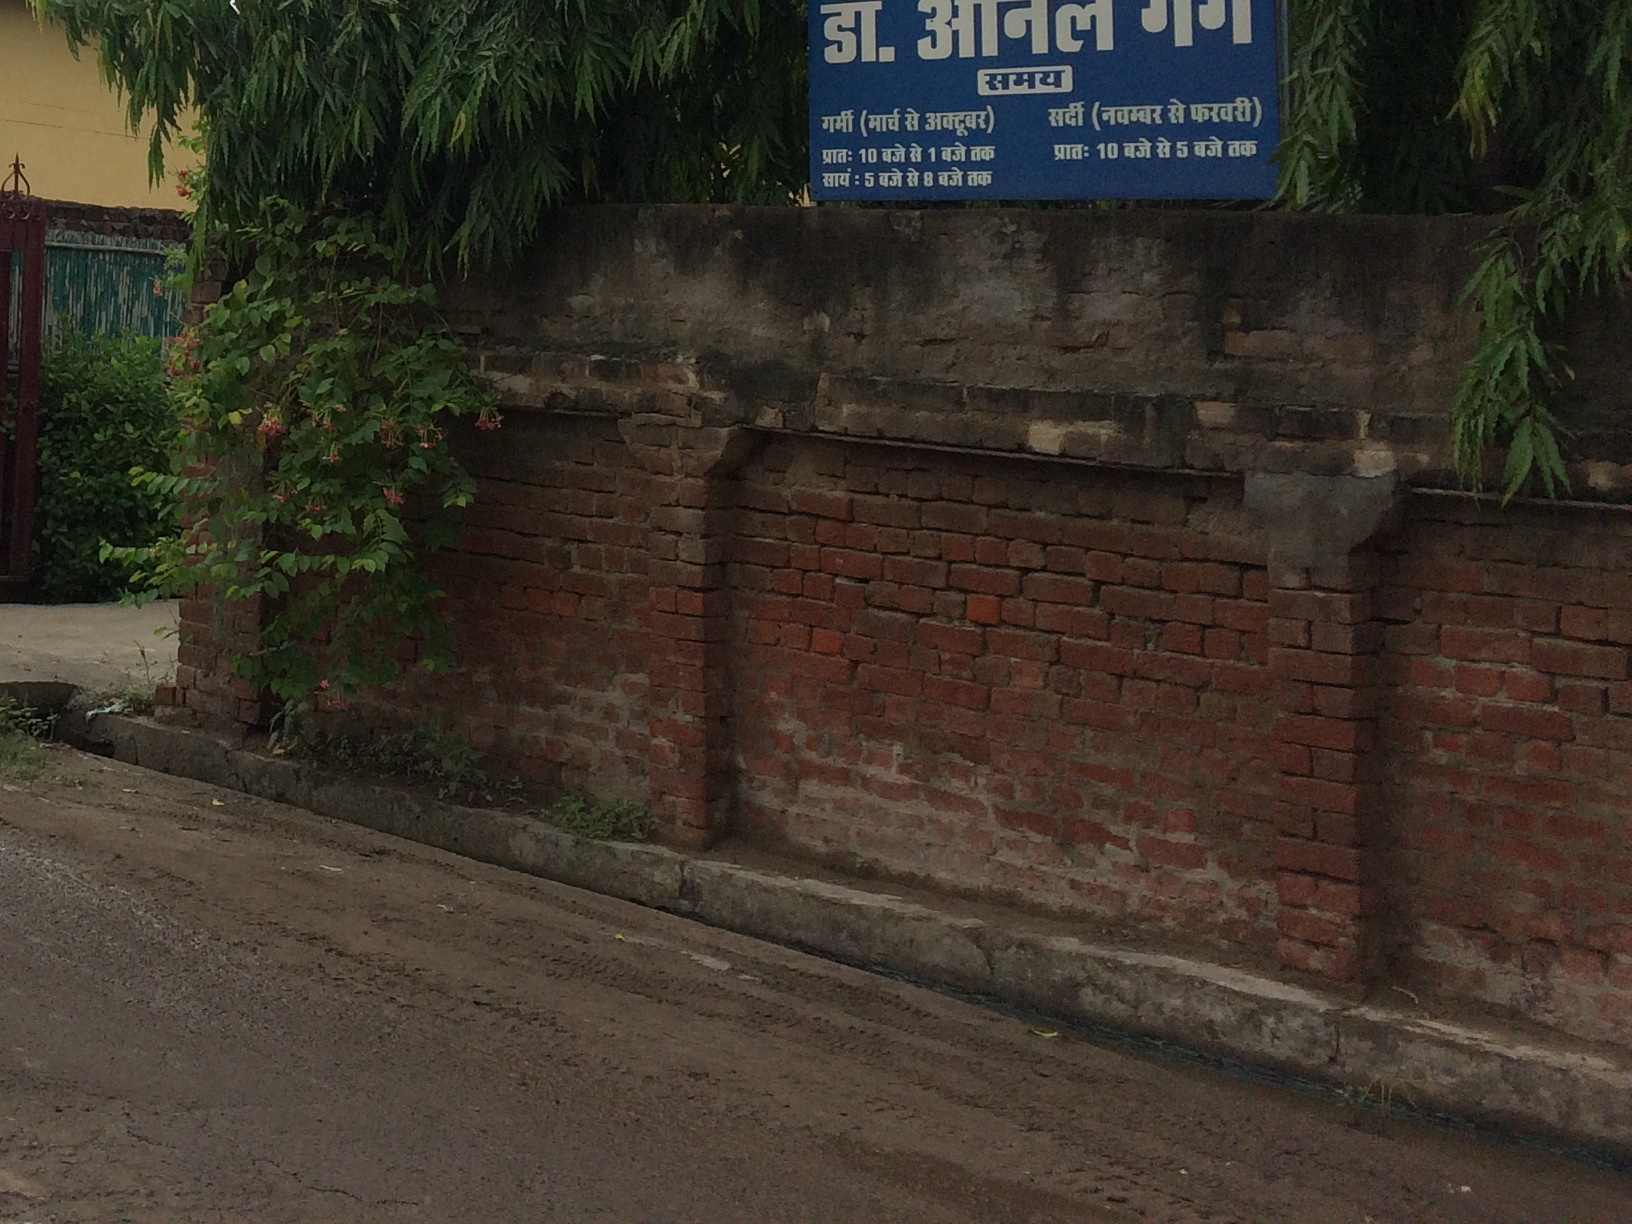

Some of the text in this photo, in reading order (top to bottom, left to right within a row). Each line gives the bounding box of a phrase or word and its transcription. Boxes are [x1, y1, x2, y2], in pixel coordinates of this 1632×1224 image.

[984, 70, 1065, 90] समय
[821, 109, 854, 133] गर्मी
[905, 108, 920, 131] से
[1048, 101, 1084, 126] सर्दी
[1168, 99, 1186, 123] से
[859, 149, 877, 163] 10
[881, 143, 905, 162] बजे
[909, 143, 922, 162] से
[928, 147, 936, 162] 1
[941, 142, 966, 161] बजे
[970, 146, 995, 161] तक
[1097, 143, 1118, 159] 10
[1123, 138, 1151, 158] बजे
[1156, 137, 1171, 158] से
[1176, 142, 1188, 158] 5
[1194, 136, 1223, 157] बजे
[1228, 140, 1257, 157] तक
[822, 168, 851, 187] सायं
[864, 172, 874, 187] 5
[878, 168, 903, 187] बजे
[907, 168, 919, 187] से
[923, 172, 933, 186] 8
[938, 167, 963, 186] बजे
[967, 171, 992, 186] तक
